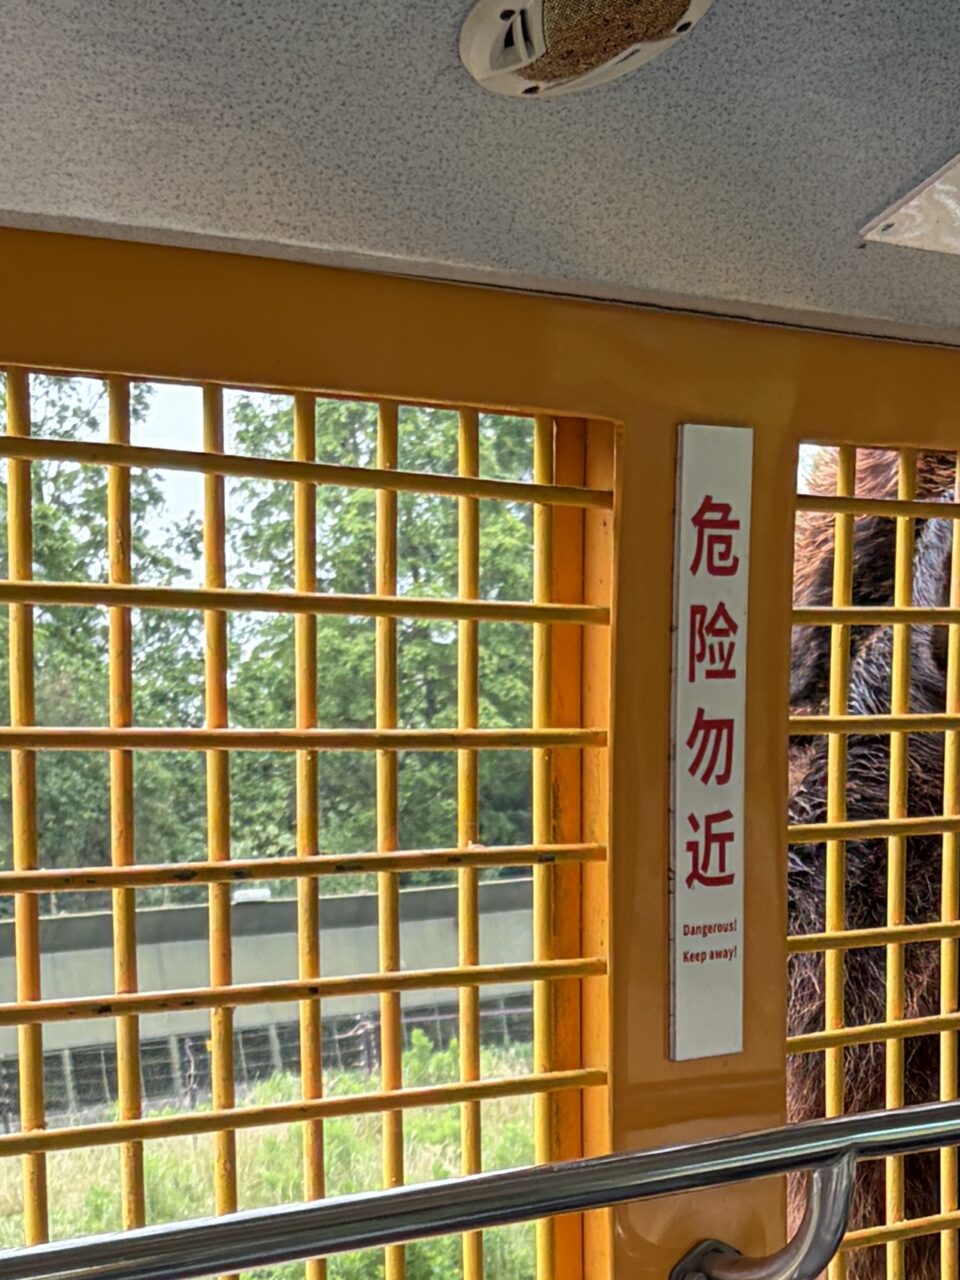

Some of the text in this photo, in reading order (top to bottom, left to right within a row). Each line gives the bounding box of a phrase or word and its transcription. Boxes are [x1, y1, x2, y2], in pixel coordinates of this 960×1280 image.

[686, 495, 741, 890] 危险勿近
[683, 918, 737, 938] Dangerous!
[683, 945, 737, 964] Keep away!
